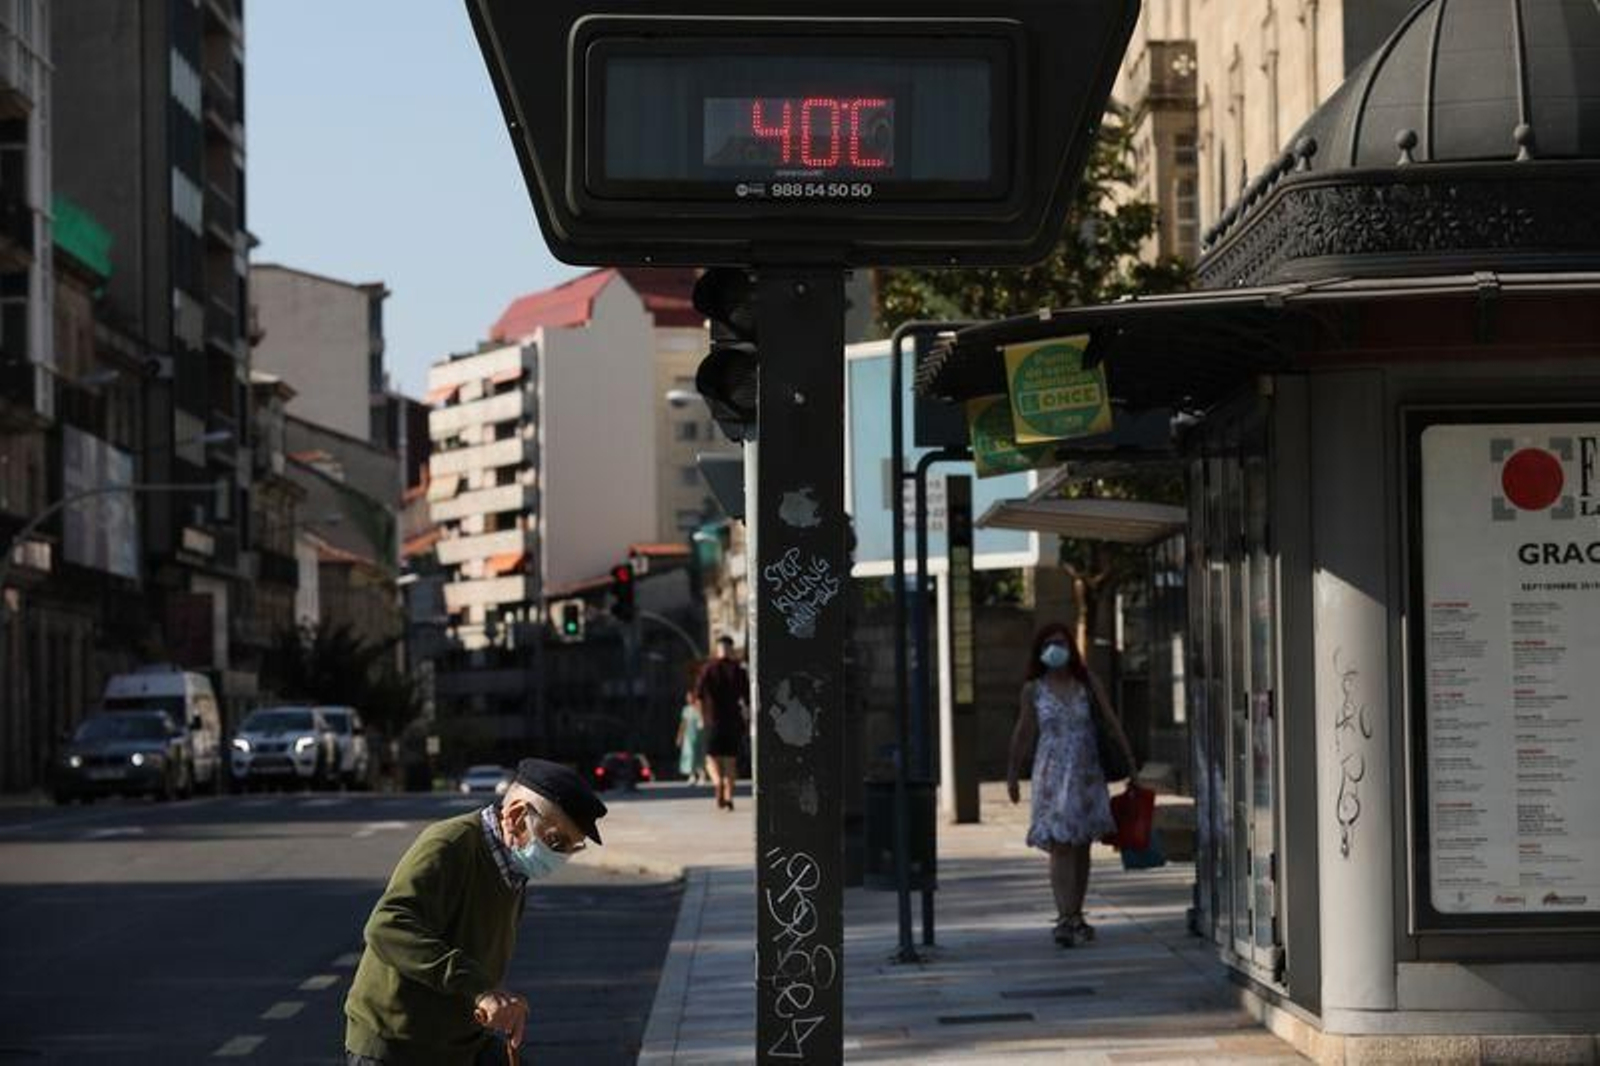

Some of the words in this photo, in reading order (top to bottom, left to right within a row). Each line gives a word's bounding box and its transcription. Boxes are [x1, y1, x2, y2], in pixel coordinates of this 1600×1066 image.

[771, 184, 802, 196] 988
[805, 184, 825, 196] 54
[828, 184, 848, 196] 50
[851, 184, 872, 196] 50
